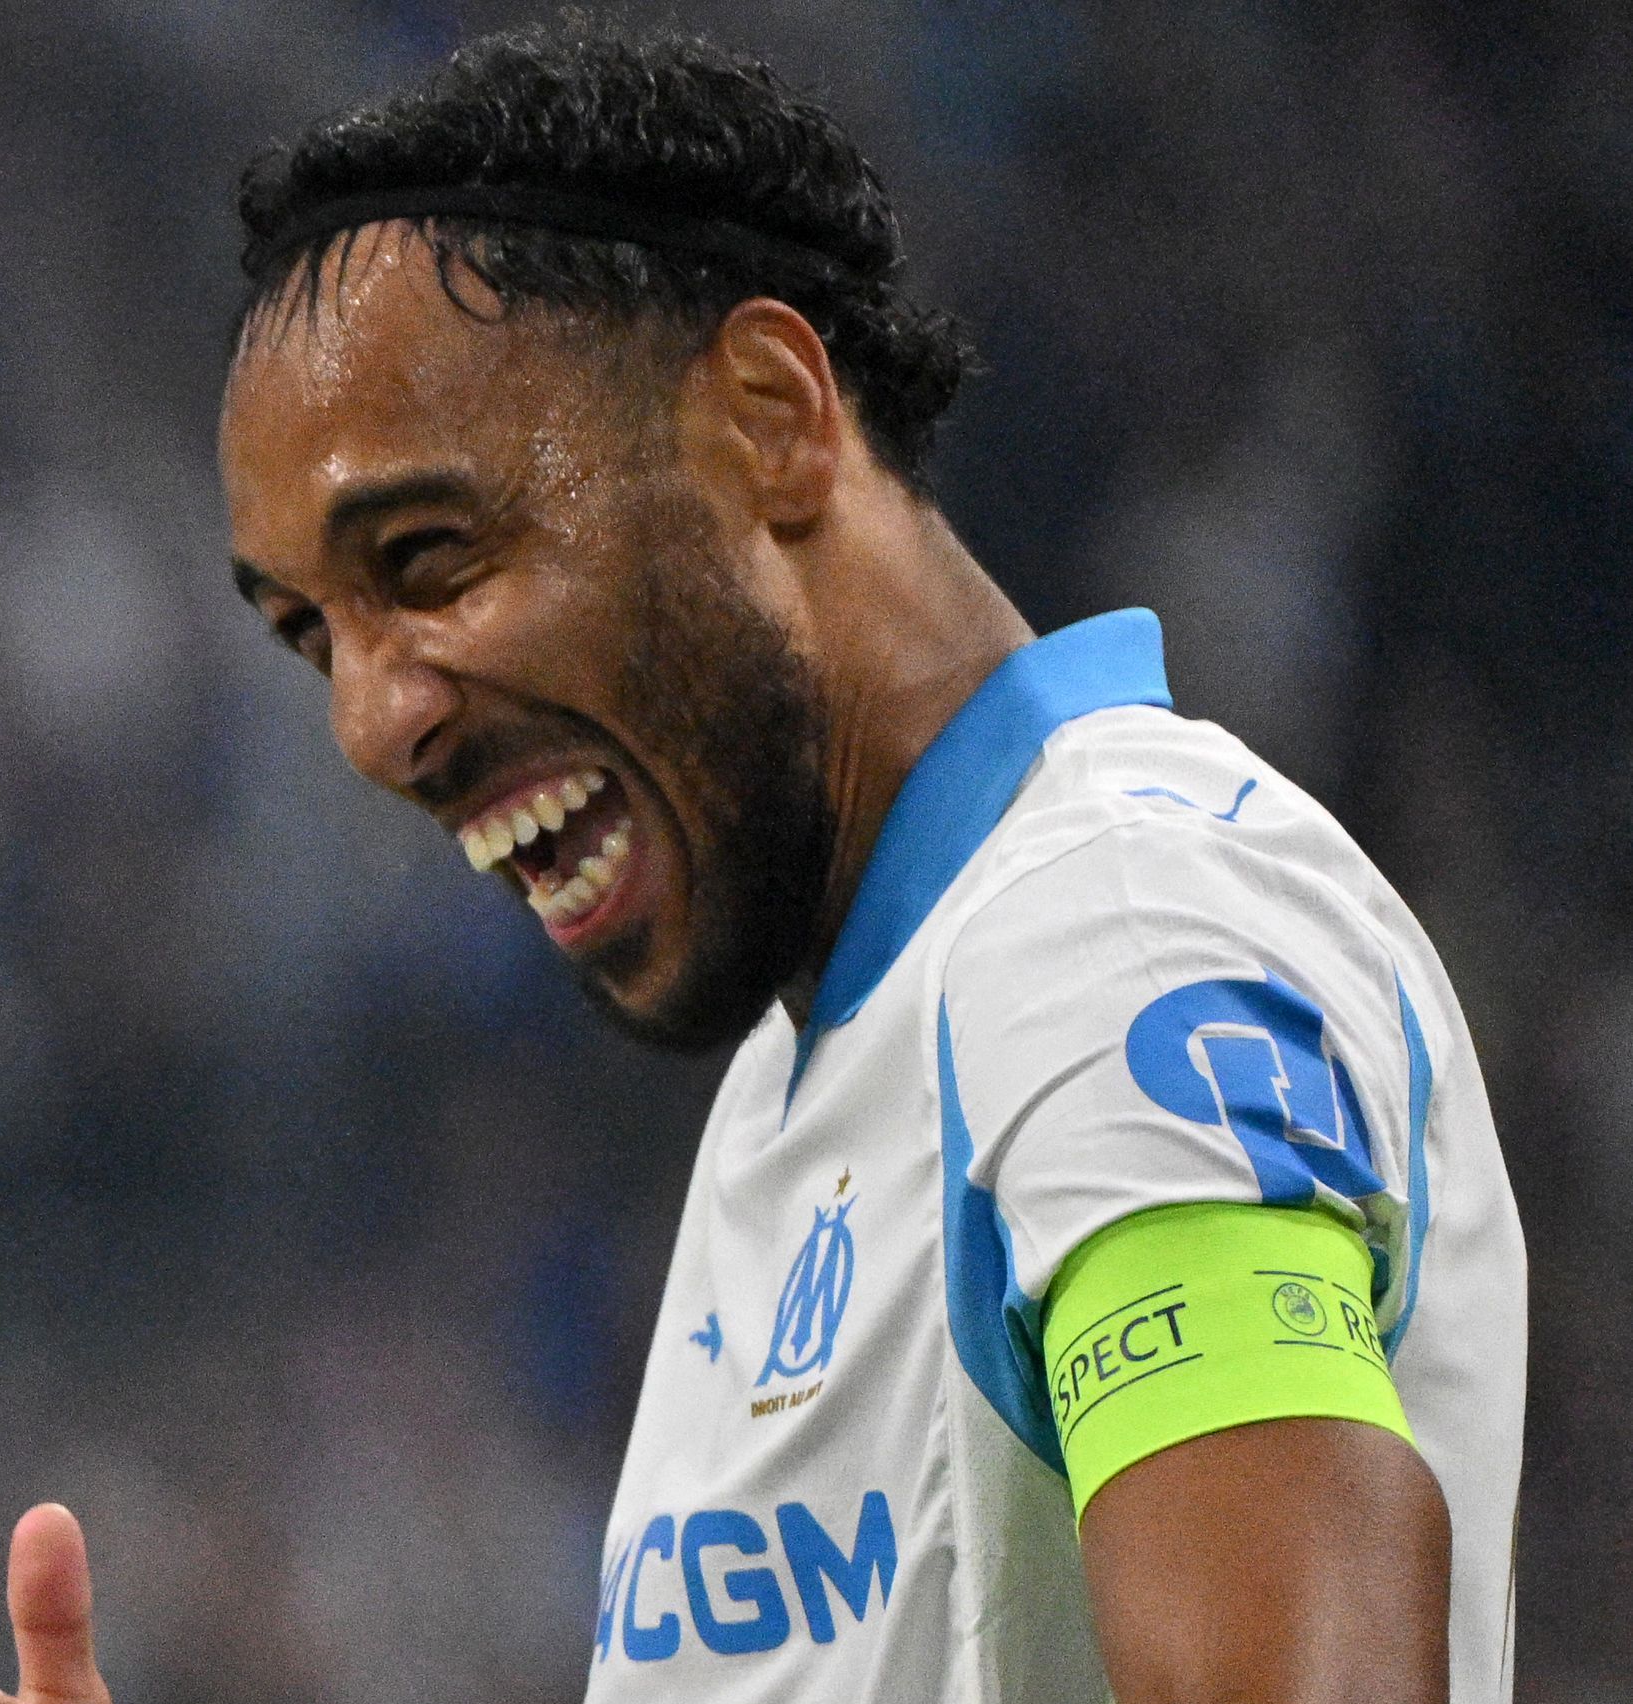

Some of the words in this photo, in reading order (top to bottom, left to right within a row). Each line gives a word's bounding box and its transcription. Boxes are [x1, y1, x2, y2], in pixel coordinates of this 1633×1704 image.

[1055, 1302, 1187, 1422] SPECT
[1339, 1300, 1384, 1362] RE
[595, 1489, 898, 1663] CGM
